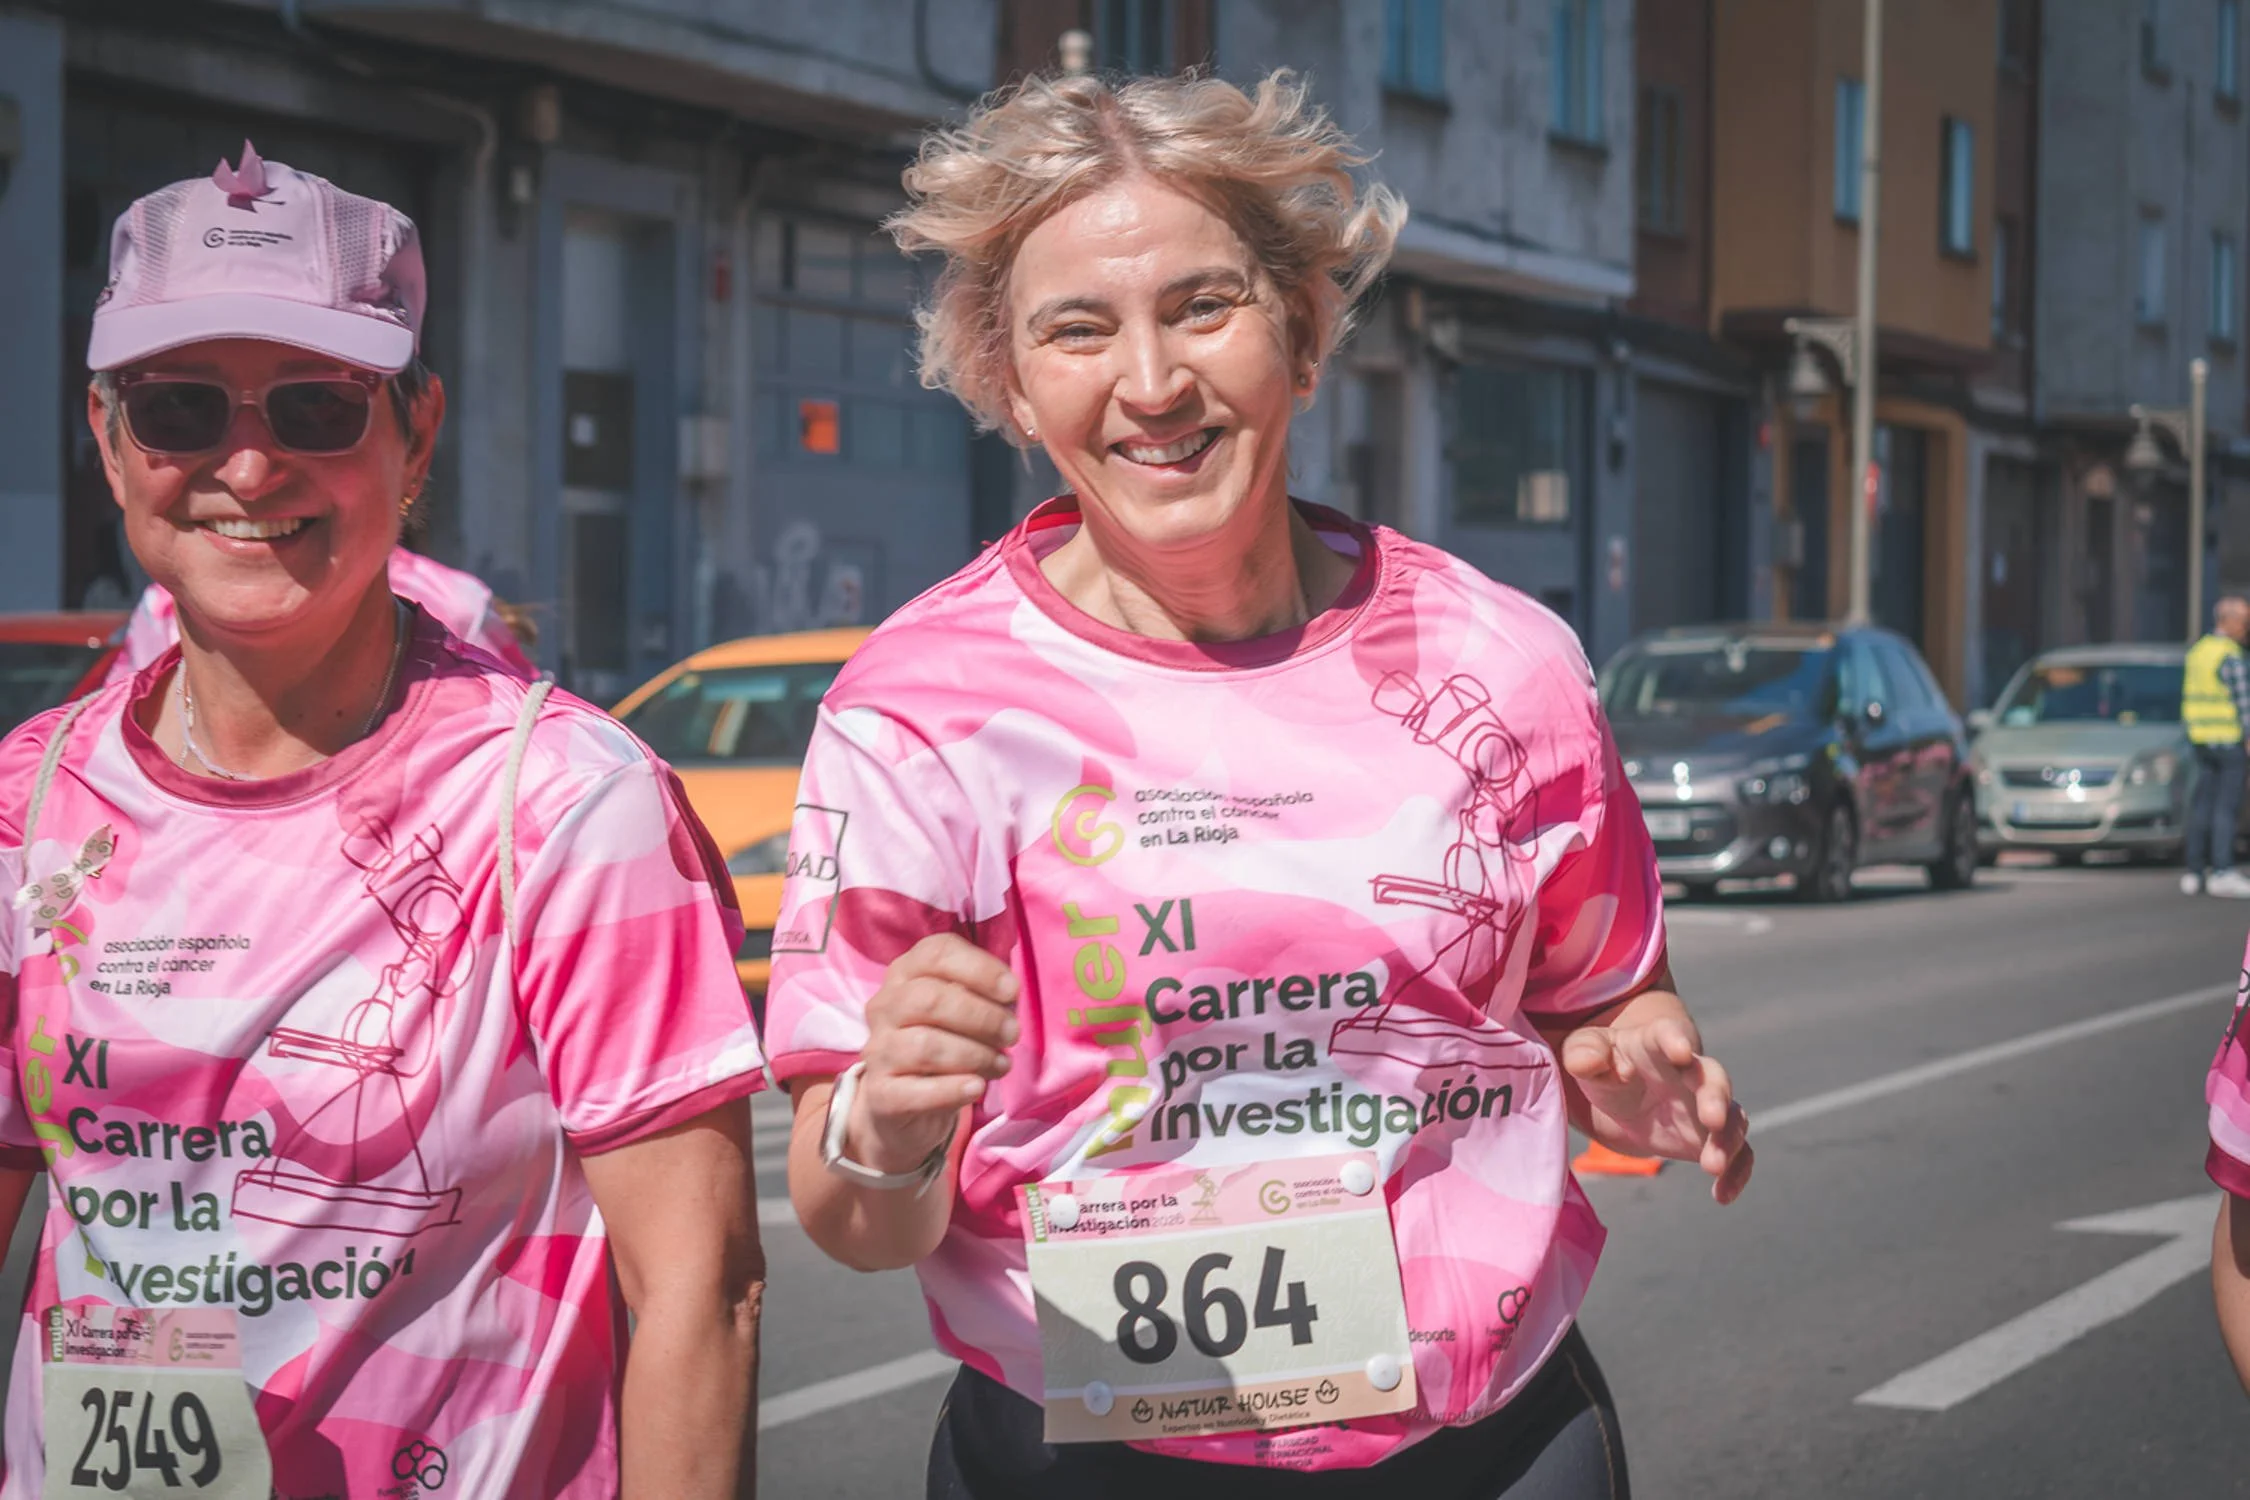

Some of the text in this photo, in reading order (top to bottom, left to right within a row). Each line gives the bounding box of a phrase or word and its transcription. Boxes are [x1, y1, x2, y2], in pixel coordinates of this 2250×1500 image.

[1137, 808, 1196, 825] contra
[1200, 806, 1216, 820] el
[1139, 825, 1239, 848] en La Rioja
[104, 934, 251, 954] asociación española
[1134, 898, 1196, 956] XI
[89, 978, 172, 998] en La Rioja
[96, 956, 216, 974] contra el cáncer
[1145, 970, 1380, 1025] Carrera
[62, 1034, 110, 1089] XI
[1160, 1031, 1317, 1099] por la
[67, 1107, 271, 1161] Carrera
[1151, 1074, 1513, 1148] investigación
[171, 1181, 220, 1232] la
[1079, 1199, 1126, 1214] arrera
[1130, 1197, 1158, 1213] por
[1161, 1194, 1179, 1207] la
[1113, 1246, 1318, 1365] 864
[1158, 1387, 1310, 1420] NATUR HOUSE
[70, 1386, 223, 1492] 2549
